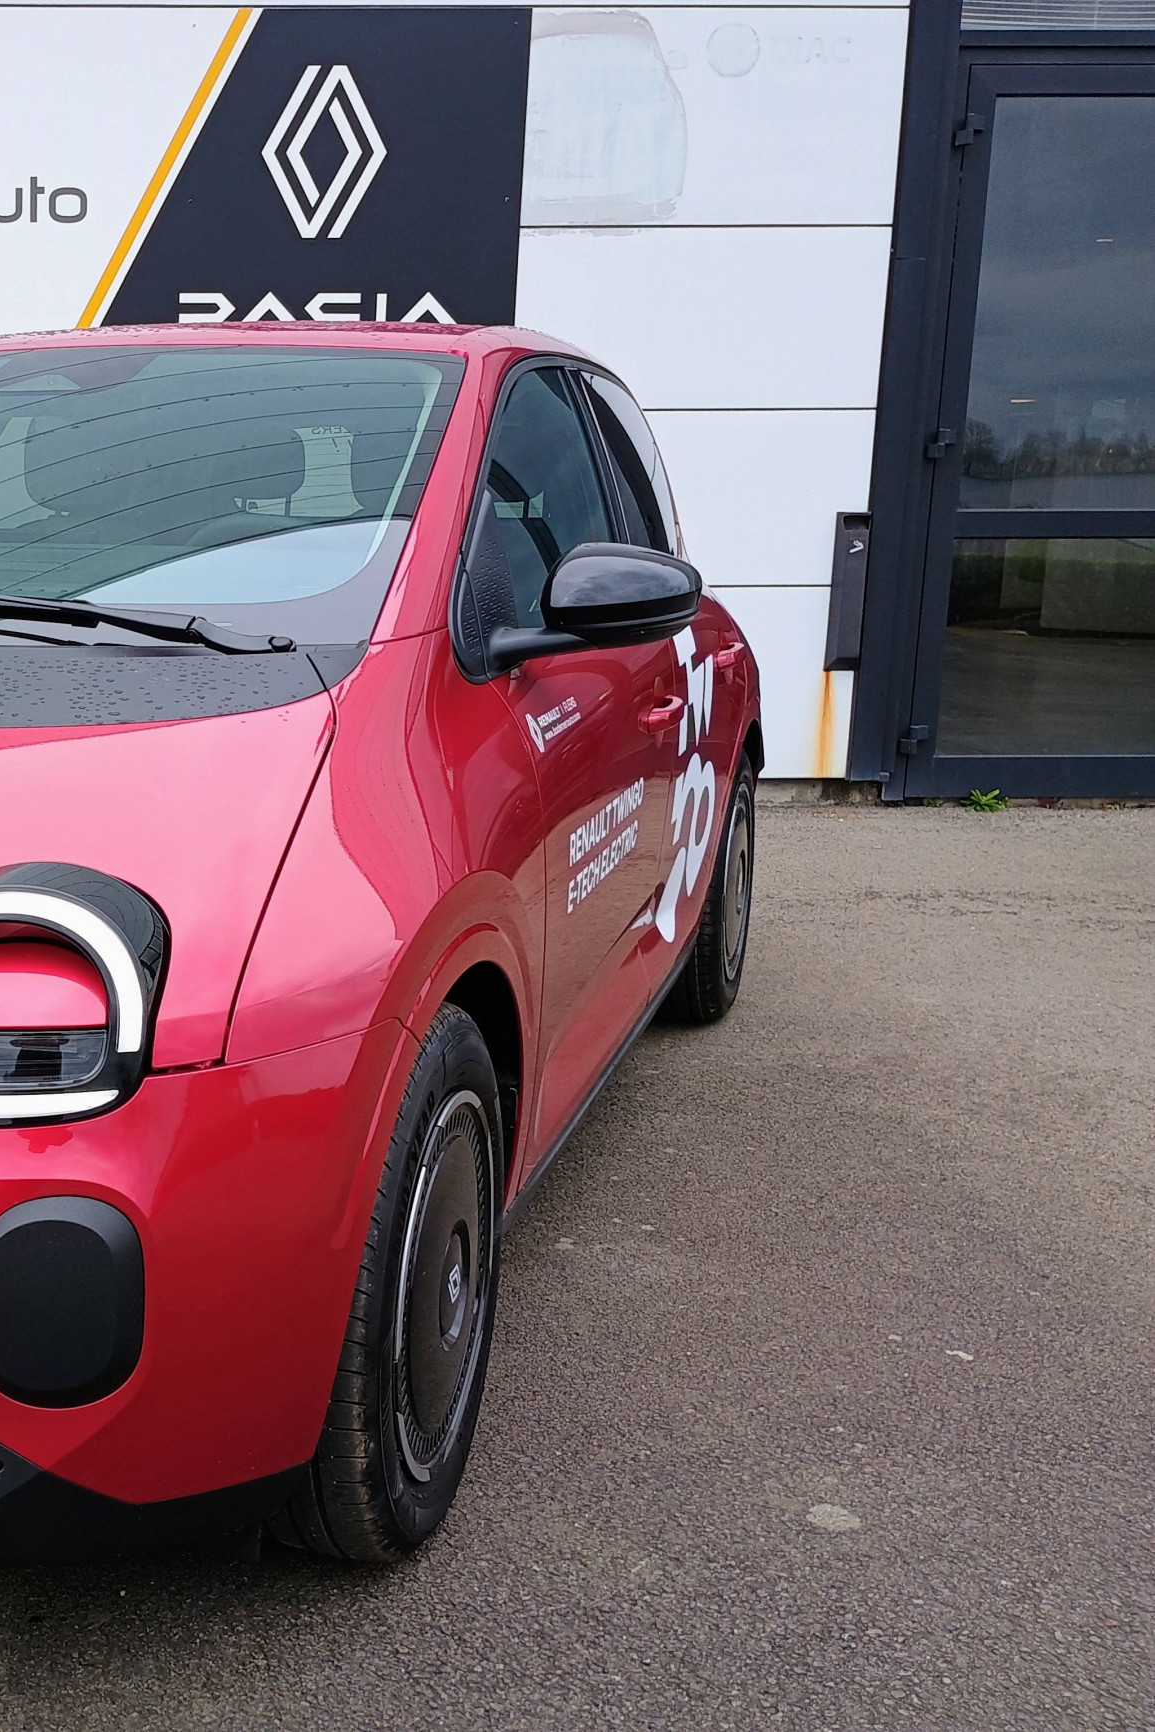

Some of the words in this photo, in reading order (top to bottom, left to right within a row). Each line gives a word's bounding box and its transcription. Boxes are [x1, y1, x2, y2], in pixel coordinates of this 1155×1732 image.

[178, 291, 457, 324] DACIA
[567, 854, 602, 914] E-TECH
[600, 820, 638, 881] ELECTRIC
[569, 802, 612, 868] RENAULT
[612, 777, 644, 829] TWINGO
